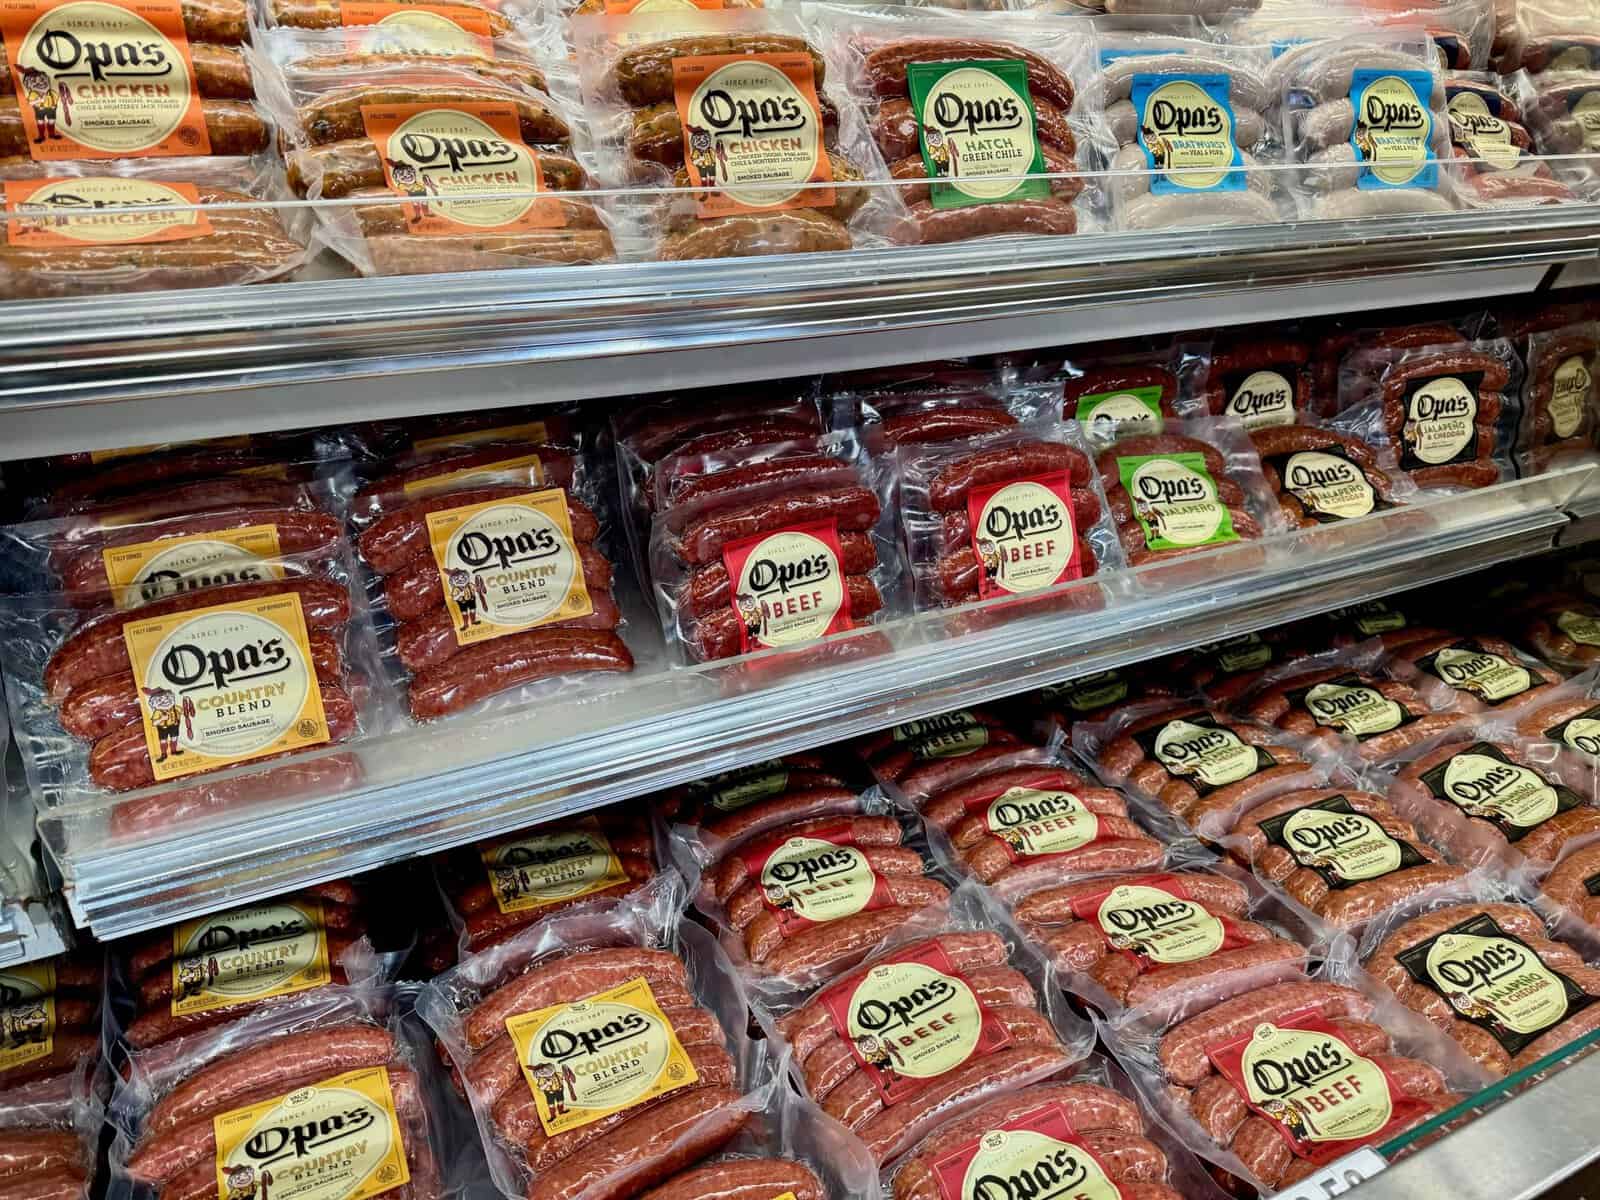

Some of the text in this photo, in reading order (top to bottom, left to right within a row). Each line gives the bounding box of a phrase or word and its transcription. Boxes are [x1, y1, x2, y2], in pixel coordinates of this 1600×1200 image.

[66, 20, 124, 28] SINCE 1947
[36, 29, 172, 82] Opa's
[76, 83, 170, 98] CHICKEN
[84, 118, 151, 127] SMOKED SAUSAGE
[700, 89, 805, 138] Opa's
[934, 92, 1022, 136] Opa's
[1152, 100, 1222, 136] Opa's
[1366, 95, 1424, 132] Opa's
[400, 133, 518, 173] Opa's
[729, 137, 802, 155] CHICKEN
[962, 148, 1024, 163] GREEN CHILE
[965, 138, 1014, 152] HATCH
[438, 170, 520, 186] CHICKEN
[737, 171, 790, 182] SMOKED SAUSAGE
[74, 211, 176, 225] CHICKEN
[1233, 389, 1286, 415] Opa's
[1417, 394, 1470, 421] Opa's
[1291, 463, 1355, 488] Opa's
[1138, 476, 1206, 505] Opa's
[1318, 484, 1365, 499] JALAPEÑO
[986, 503, 1062, 541] Opa's
[1165, 503, 1216, 516] JALAPEÑO
[457, 528, 560, 571] Opa's
[1010, 539, 1055, 563] BEEF
[486, 563, 558, 588] COUNTRY
[502, 578, 546, 595] BLEND
[749, 553, 830, 596] Opa's
[772, 591, 822, 619] BEEF
[161, 636, 290, 692] Opa's
[1443, 655, 1499, 681] Opa's
[196, 681, 286, 711] COUNTRY
[216, 698, 272, 719] BLEND
[1312, 690, 1376, 715] Opa's
[205, 717, 271, 737] SMOKED SAUSAGE
[931, 730, 970, 747] BEEF
[1162, 731, 1230, 760] Opa's
[1452, 766, 1521, 801] Opa's
[995, 795, 1075, 827] Opa's
[1030, 815, 1077, 836] BEEF
[1292, 816, 1369, 850] Opa's
[530, 855, 593, 880] COUNTRY
[545, 869, 585, 884] BLEND
[770, 849, 857, 885] Opa's
[802, 877, 854, 895] BEEF
[1107, 900, 1195, 930] Opa's
[198, 919, 307, 952] Opa's
[220, 943, 299, 970] COUNTRY
[236, 959, 285, 975] BLEND
[1438, 943, 1525, 988] Opa's
[1487, 972, 1543, 1002] JALAPEÑO
[857, 978, 955, 1028] Opa's
[541, 1012, 649, 1057] Opa's
[898, 1012, 957, 1047] BEEF
[575, 1040, 649, 1076] COUNTRY
[592, 1058, 640, 1082] BLEND
[1252, 1040, 1351, 1096] Opa's
[1304, 1074, 1362, 1113] BEEF
[245, 1106, 374, 1160] Opa's
[275, 1139, 368, 1181] COUNTRY
[295, 1160, 351, 1181] BLEND
[973, 1148, 1087, 1200] Opa's
[280, 1171, 349, 1199] SMOKED SAUSAGE
